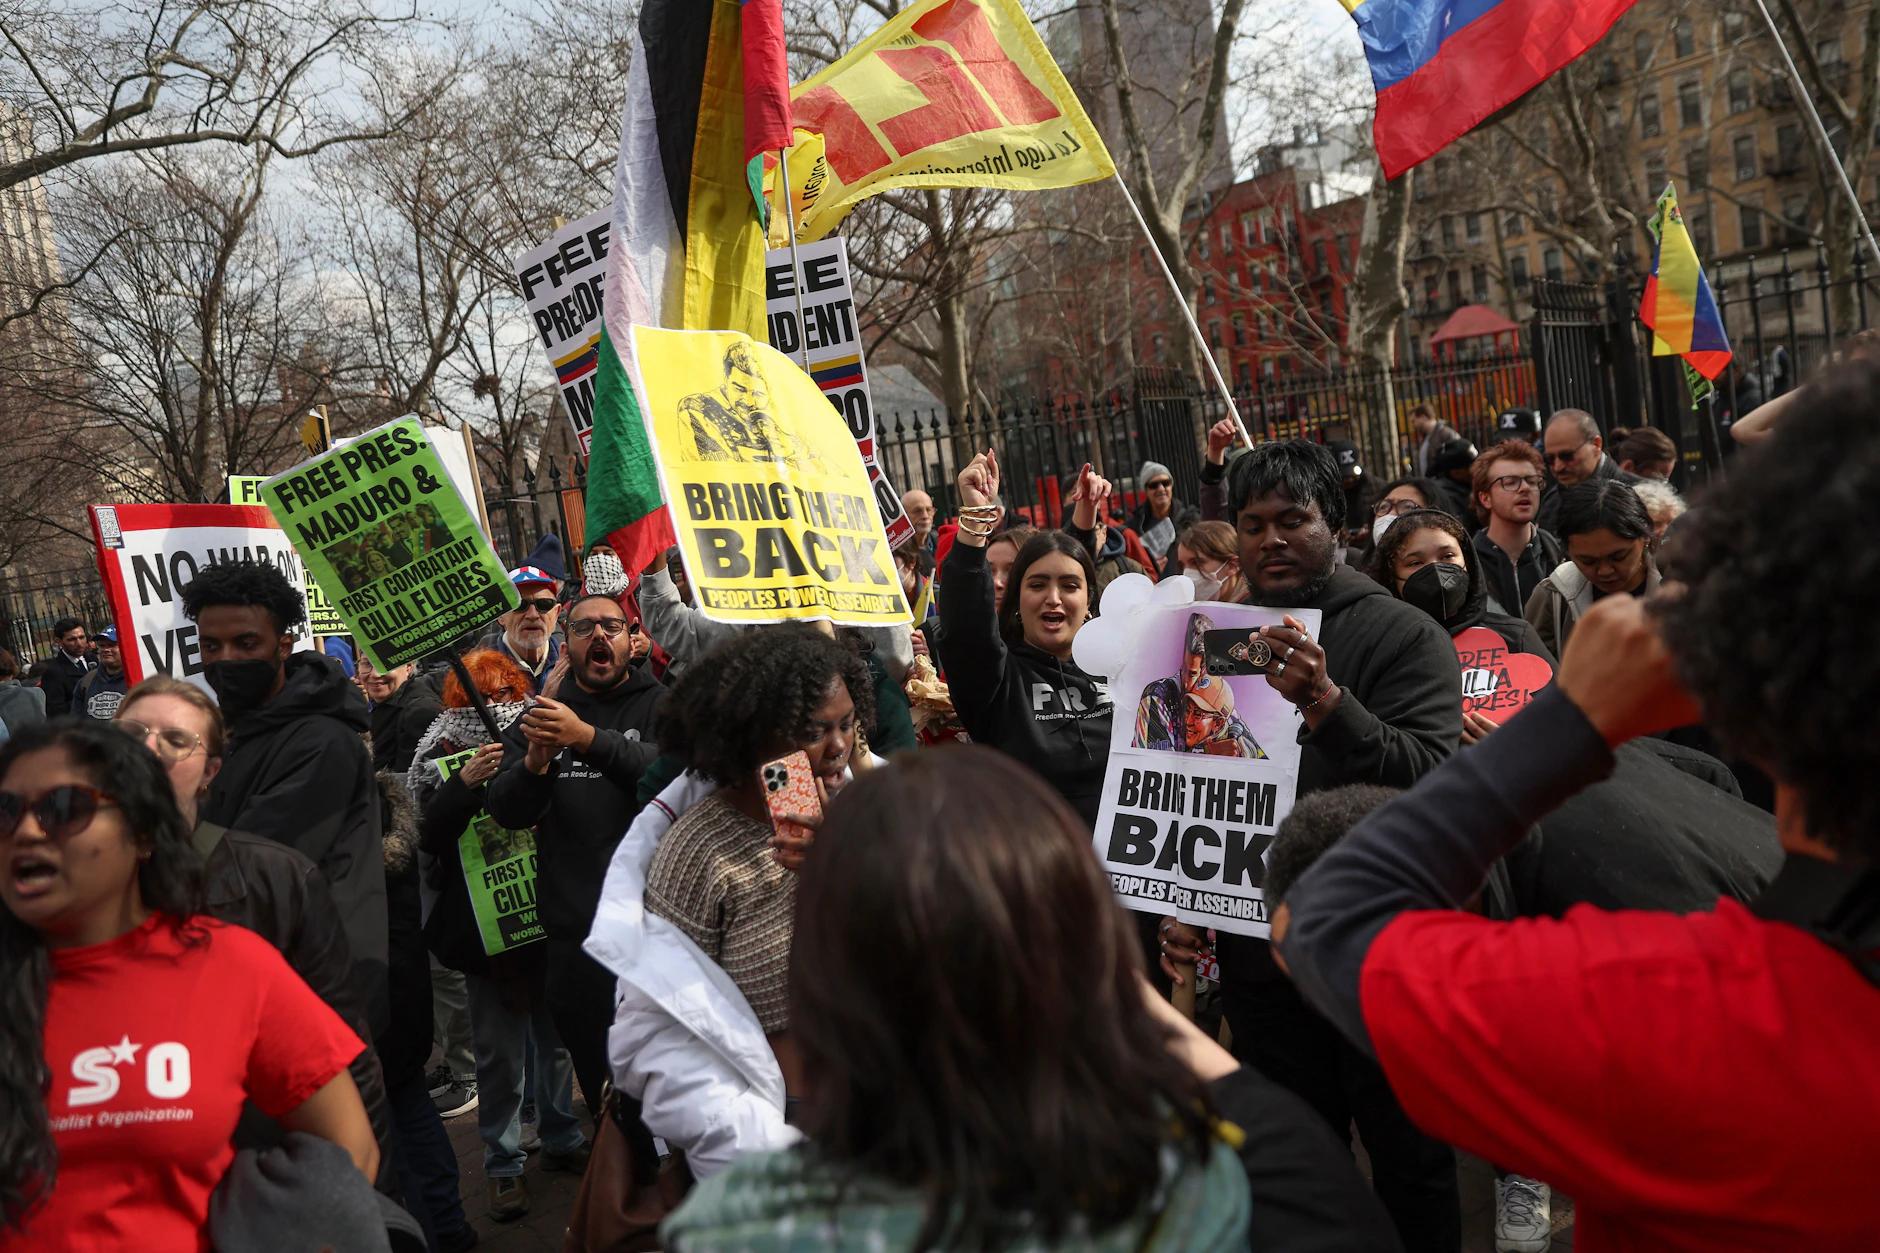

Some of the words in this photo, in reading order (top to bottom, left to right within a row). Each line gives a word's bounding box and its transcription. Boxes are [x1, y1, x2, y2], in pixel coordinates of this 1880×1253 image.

[765, 253, 845, 300] EE
[766, 298, 857, 354] IDENT
[273, 460, 341, 515] FREE
[340, 426, 427, 482] PRES.
[296, 475, 413, 551] MADURO
[412, 464, 443, 495] &
[682, 481, 796, 521] BRING
[793, 485, 873, 532] THEM
[131, 550, 200, 606] NO
[276, 549, 299, 583] ON
[339, 581, 383, 618] FIRST
[383, 535, 480, 598] COMBATANT
[693, 527, 891, 586] BACK
[357, 599, 415, 641] CILIA
[409, 560, 492, 617] FLORES
[389, 594, 488, 649] WORKERS.ORG
[707, 590, 778, 610] PEOPLES
[828, 592, 896, 613] ASSEMBLY
[387, 637, 437, 665] WORKERS
[434, 620, 470, 643] WORLD
[469, 601, 505, 628] PARTY
[1461, 688, 1530, 713] ORES!
[1463, 668, 1513, 694] ILIA
[1035, 712, 1064, 721] Freedom
[570, 770, 588, 778] Road
[1190, 775, 1278, 827] THEM
[482, 858, 526, 890] FIRST
[1106, 812, 1276, 890] BACK
[492, 878, 537, 914] CILI
[1167, 883, 1192, 909] PER
[1193, 892, 1268, 923] ASSEMBLY
[510, 925, 546, 942] WORK
[48, 1113, 94, 1133] ialist
[96, 1105, 194, 1128] Organization
